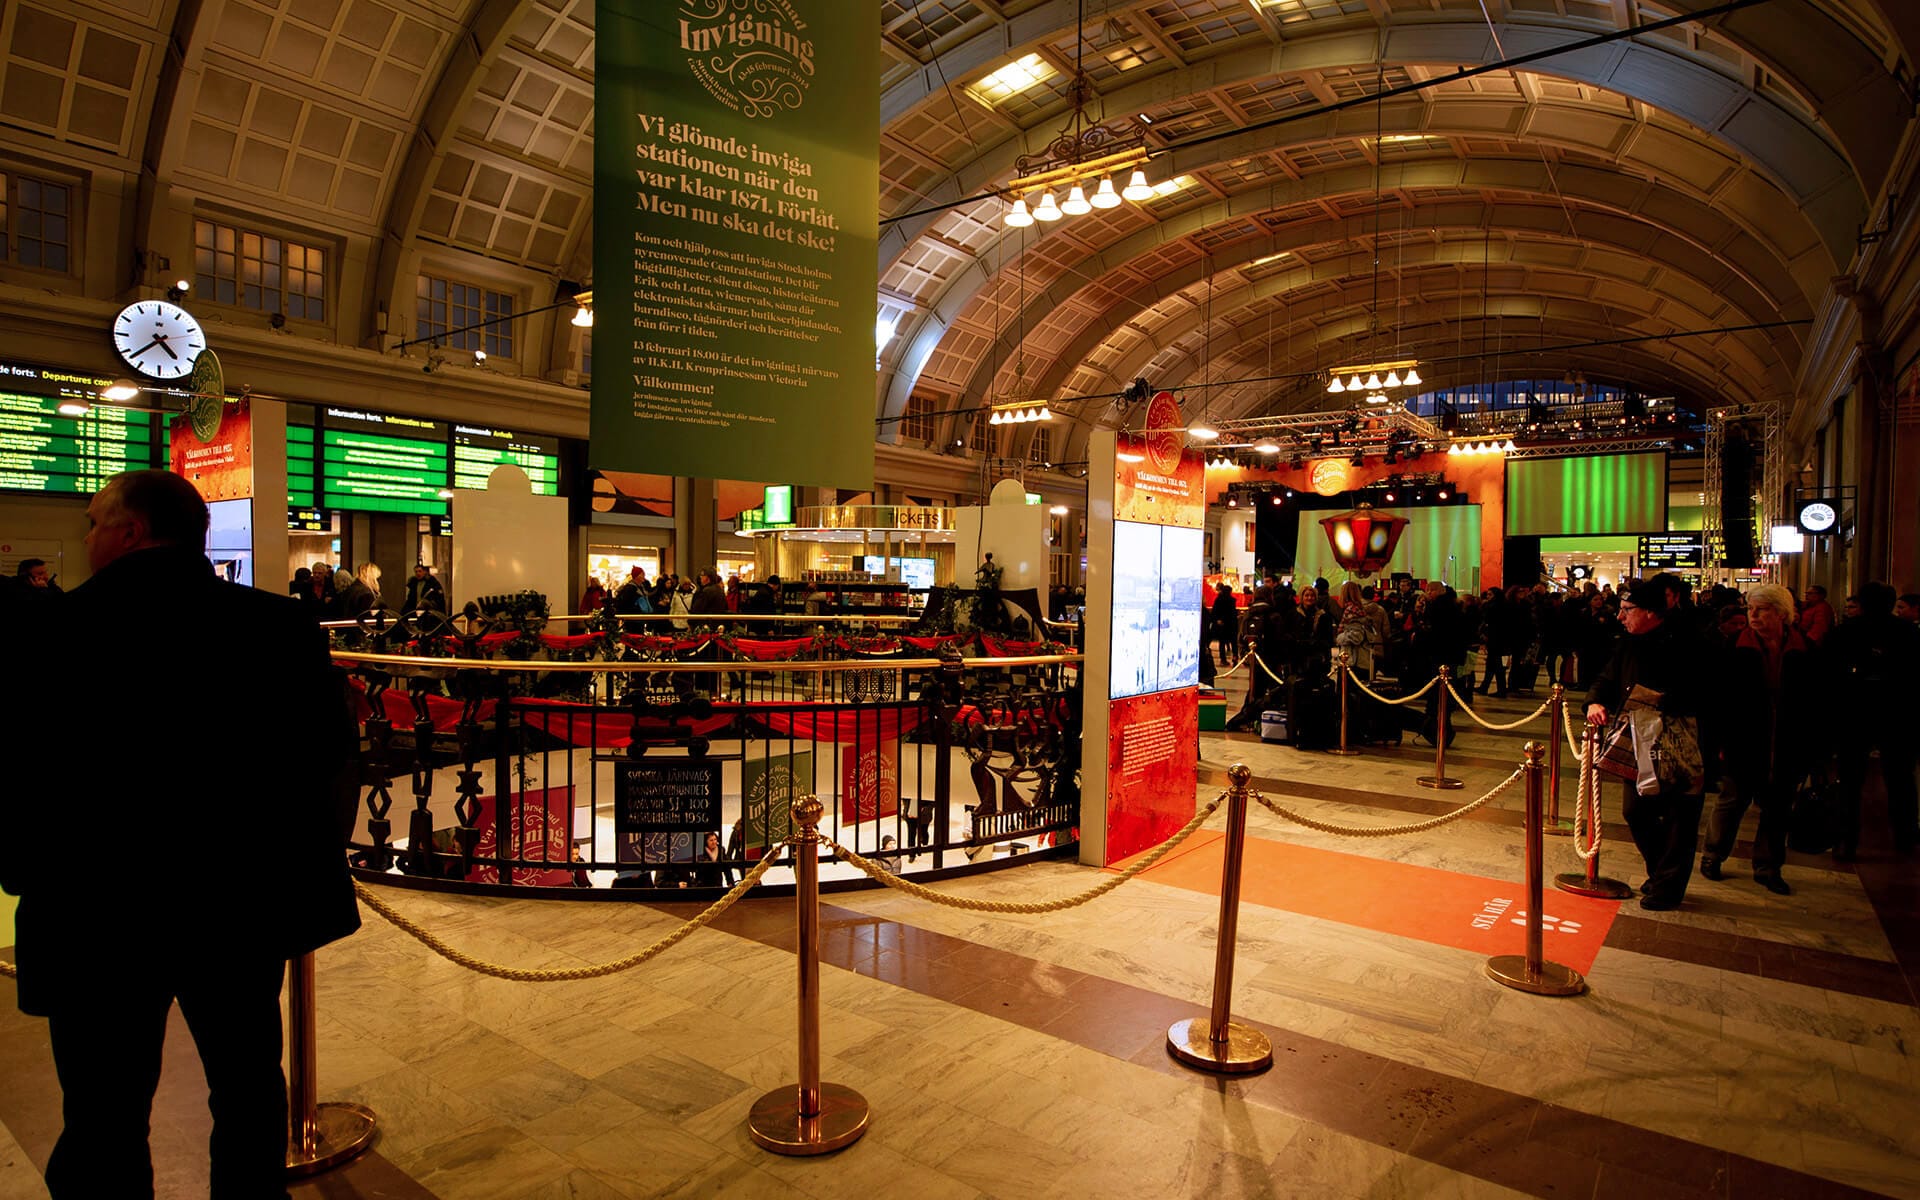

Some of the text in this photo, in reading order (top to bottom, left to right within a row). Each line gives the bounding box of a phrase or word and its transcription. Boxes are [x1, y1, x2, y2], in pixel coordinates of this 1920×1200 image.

[678, 12, 815, 76] Invigning
[638, 114, 811, 176] Vi glömde inviga
[636, 143, 818, 202] stationen när den
[636, 169, 839, 230] var klar 1871. Förlåt.
[635, 191, 835, 252] Men nu ska det ske!
[635, 232, 833, 280] Kom och hjälp oss att inviga Stockholms
[635, 248, 820, 290] nyrenoverade Centralstation. Det blir
[634, 275, 659, 288] Erik
[661, 281, 680, 291] och
[683, 283, 714, 298] Lotta,
[715, 290, 773, 308] wienervals,
[799, 305, 816, 315] där
[635, 260, 712, 283] högtidligheter,
[713, 275, 740, 289] silent
[743, 281, 771, 295] disco,
[634, 290, 842, 334] elektroniska skärmar, butikserbjudanden,
[634, 302, 692, 321] barndisco,
[749, 323, 765, 333] och
[767, 326, 820, 342] berättelser
[634, 317, 657, 330] från
[659, 321, 681, 333] förr
[688, 326, 718, 339] tiden,
[12, 366, 37, 377] forts.
[42, 371, 92, 386] Departures
[633, 356, 809, 387] av H.K.H. Kronprinsessan Victoria
[634, 340, 644, 350] 13
[645, 342, 691, 357] februari
[692, 348, 719, 361] 18.00
[720, 352, 732, 363] är
[734, 355, 749, 365] det
[751, 357, 796, 375] invigning
[802, 366, 839, 379] närvaro
[632, 374, 715, 395] Välkommen!
[328, 408, 365, 420] Information
[888, 512, 939, 525] TICKETS
[684, 811, 711, 824] 1956
[1470, 912, 1499, 931] STÅ
